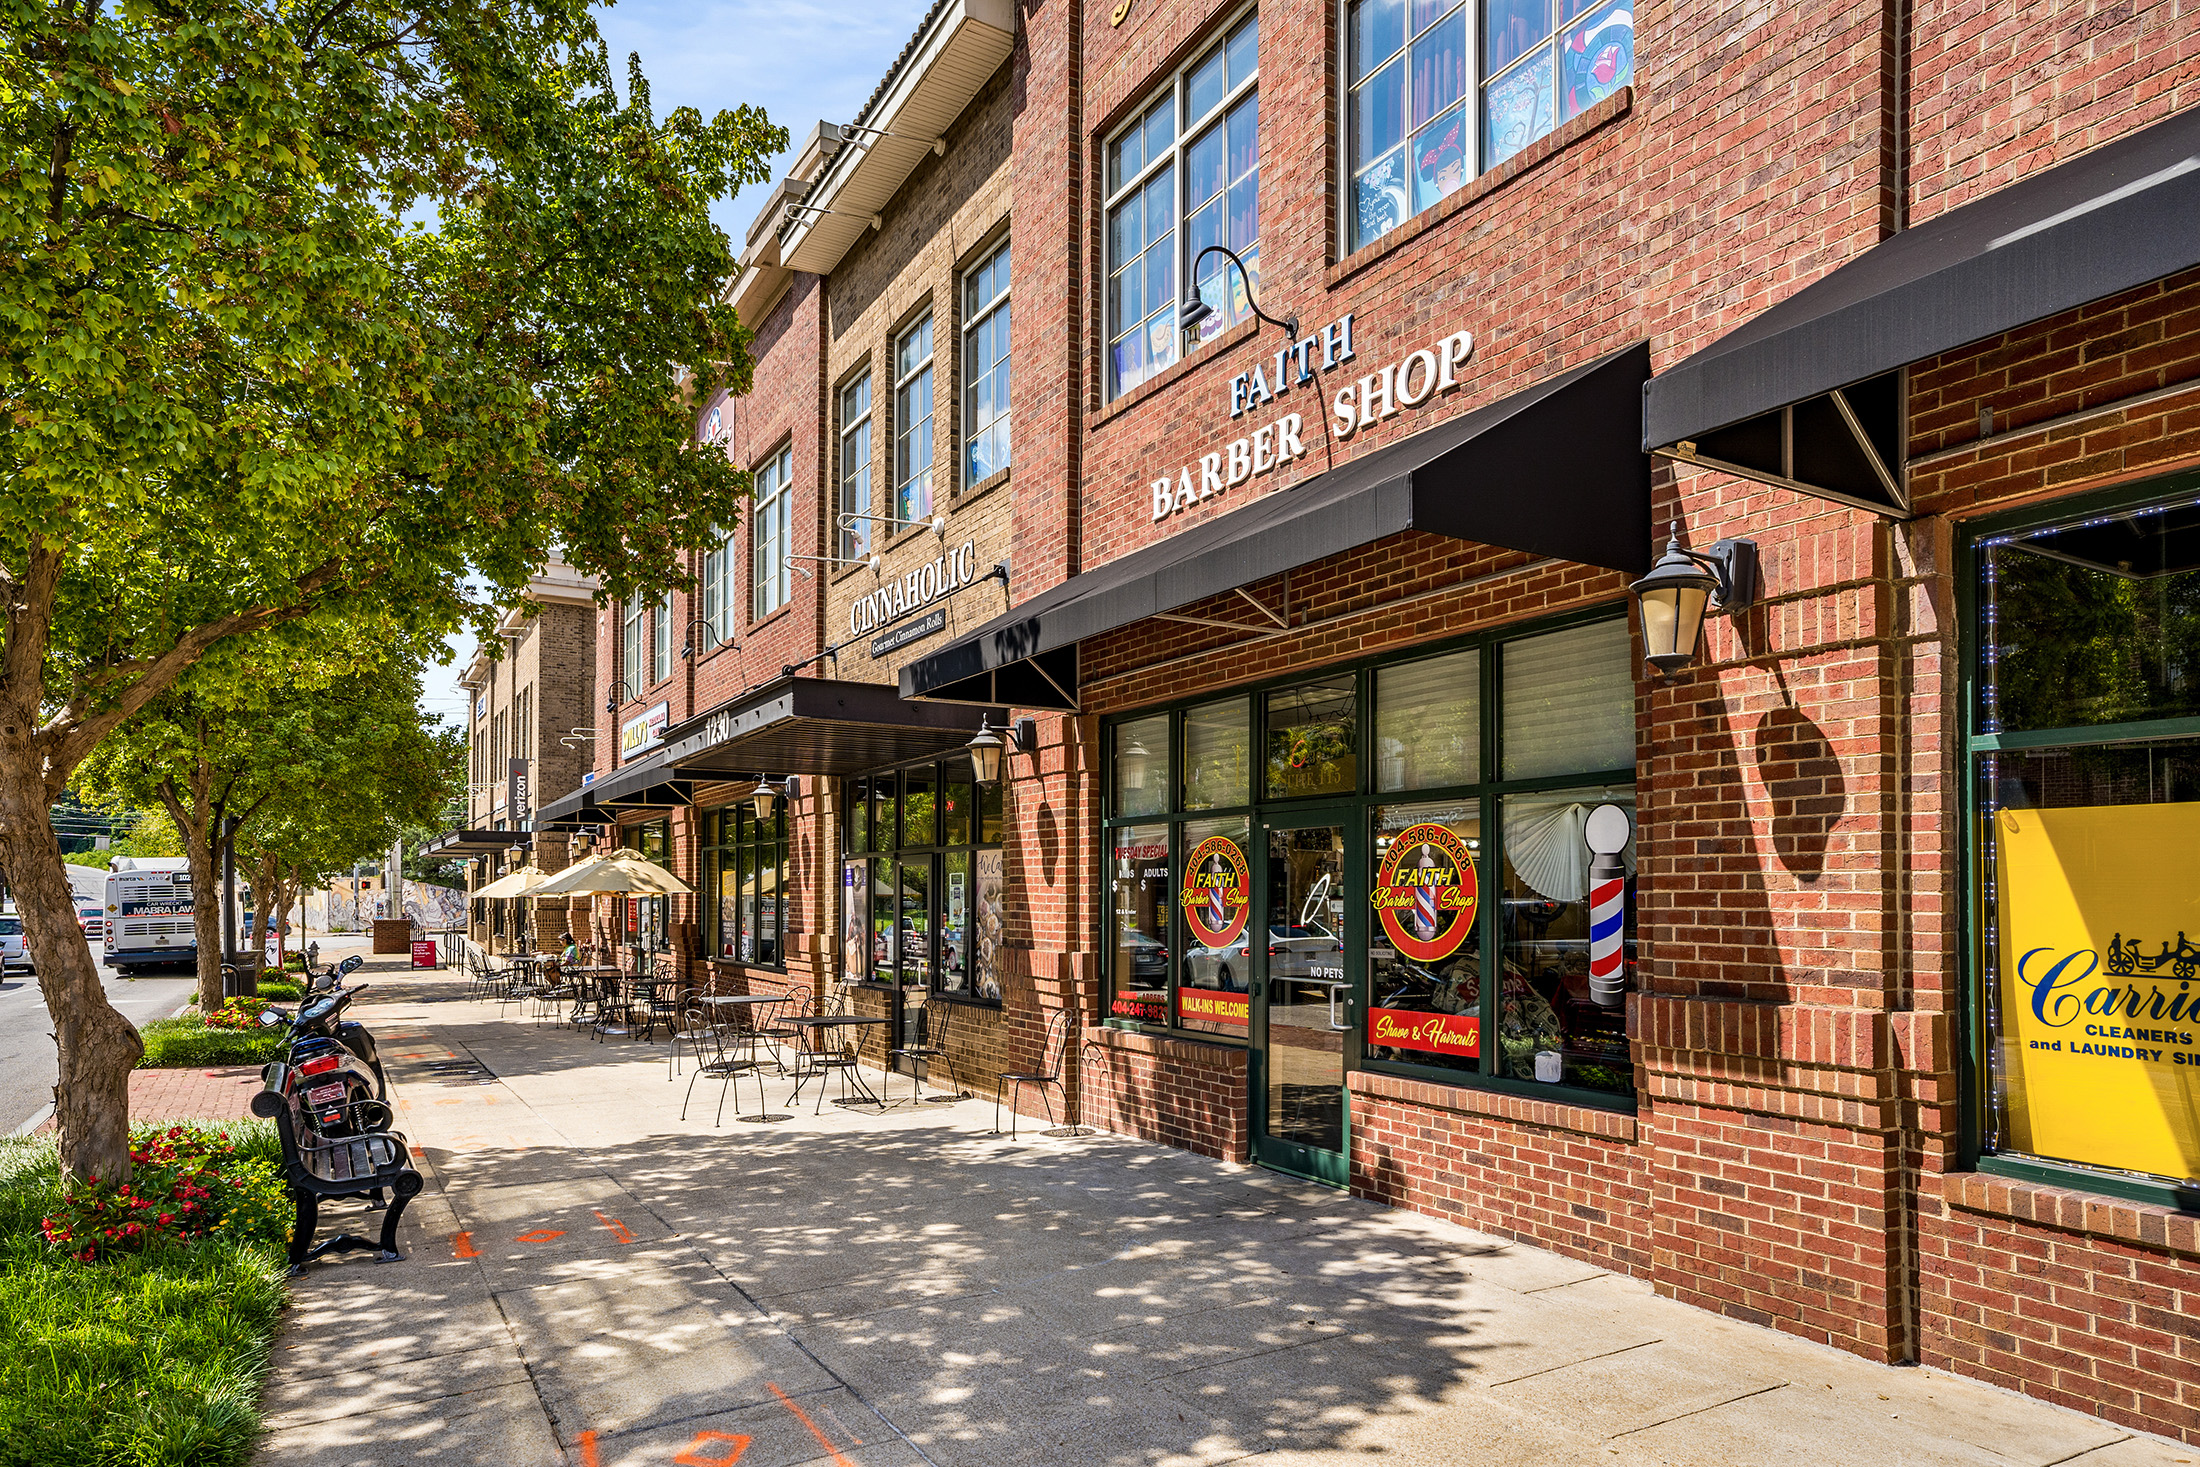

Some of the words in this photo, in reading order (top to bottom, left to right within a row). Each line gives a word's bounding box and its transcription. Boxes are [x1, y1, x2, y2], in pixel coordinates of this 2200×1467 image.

[1229, 313, 1355, 418] FAITH
[1150, 413, 1306, 522] BARBER
[1332, 330, 1474, 438] SHOP
[850, 539, 975, 636] CINNAHOLIC
[872, 637, 895, 654] Gourmet
[895, 624, 926, 643] Cinnamon
[926, 613, 942, 630] Rolls
[623, 720, 648, 752] WILLY'S
[705, 710, 730, 746] 1230
[514, 775, 526, 818] verizon
[1115, 847, 1141, 860] TUESDAY
[1189, 840, 1246, 876] 404-586-0268
[1384, 828, 1471, 872] 404-586-0268
[1143, 868, 1169, 878] ADULTS
[1195, 872, 1236, 888] FAITH
[1394, 867, 1455, 887] FAITH
[133, 906, 172, 915] MABRA
[1179, 888, 1210, 907] Barber
[1225, 888, 1249, 910] Shop
[1369, 886, 1416, 910] Barber
[1440, 886, 1475, 914] Shop
[1310, 966, 1322, 977] NO
[1323, 967, 1344, 979] PETS
[1181, 996, 1214, 1014] WALK-INS
[1214, 1000, 1249, 1018] WELCOME
[1375, 1015, 1409, 1040] Shave
[1412, 1026, 1421, 1041] &
[1422, 1017, 1478, 1049] Haircuts
[2085, 1024, 2193, 1045] CLEANERS
[2029, 1040, 2062, 1051] and
[2070, 1041, 2163, 1062] LAUNDRY
